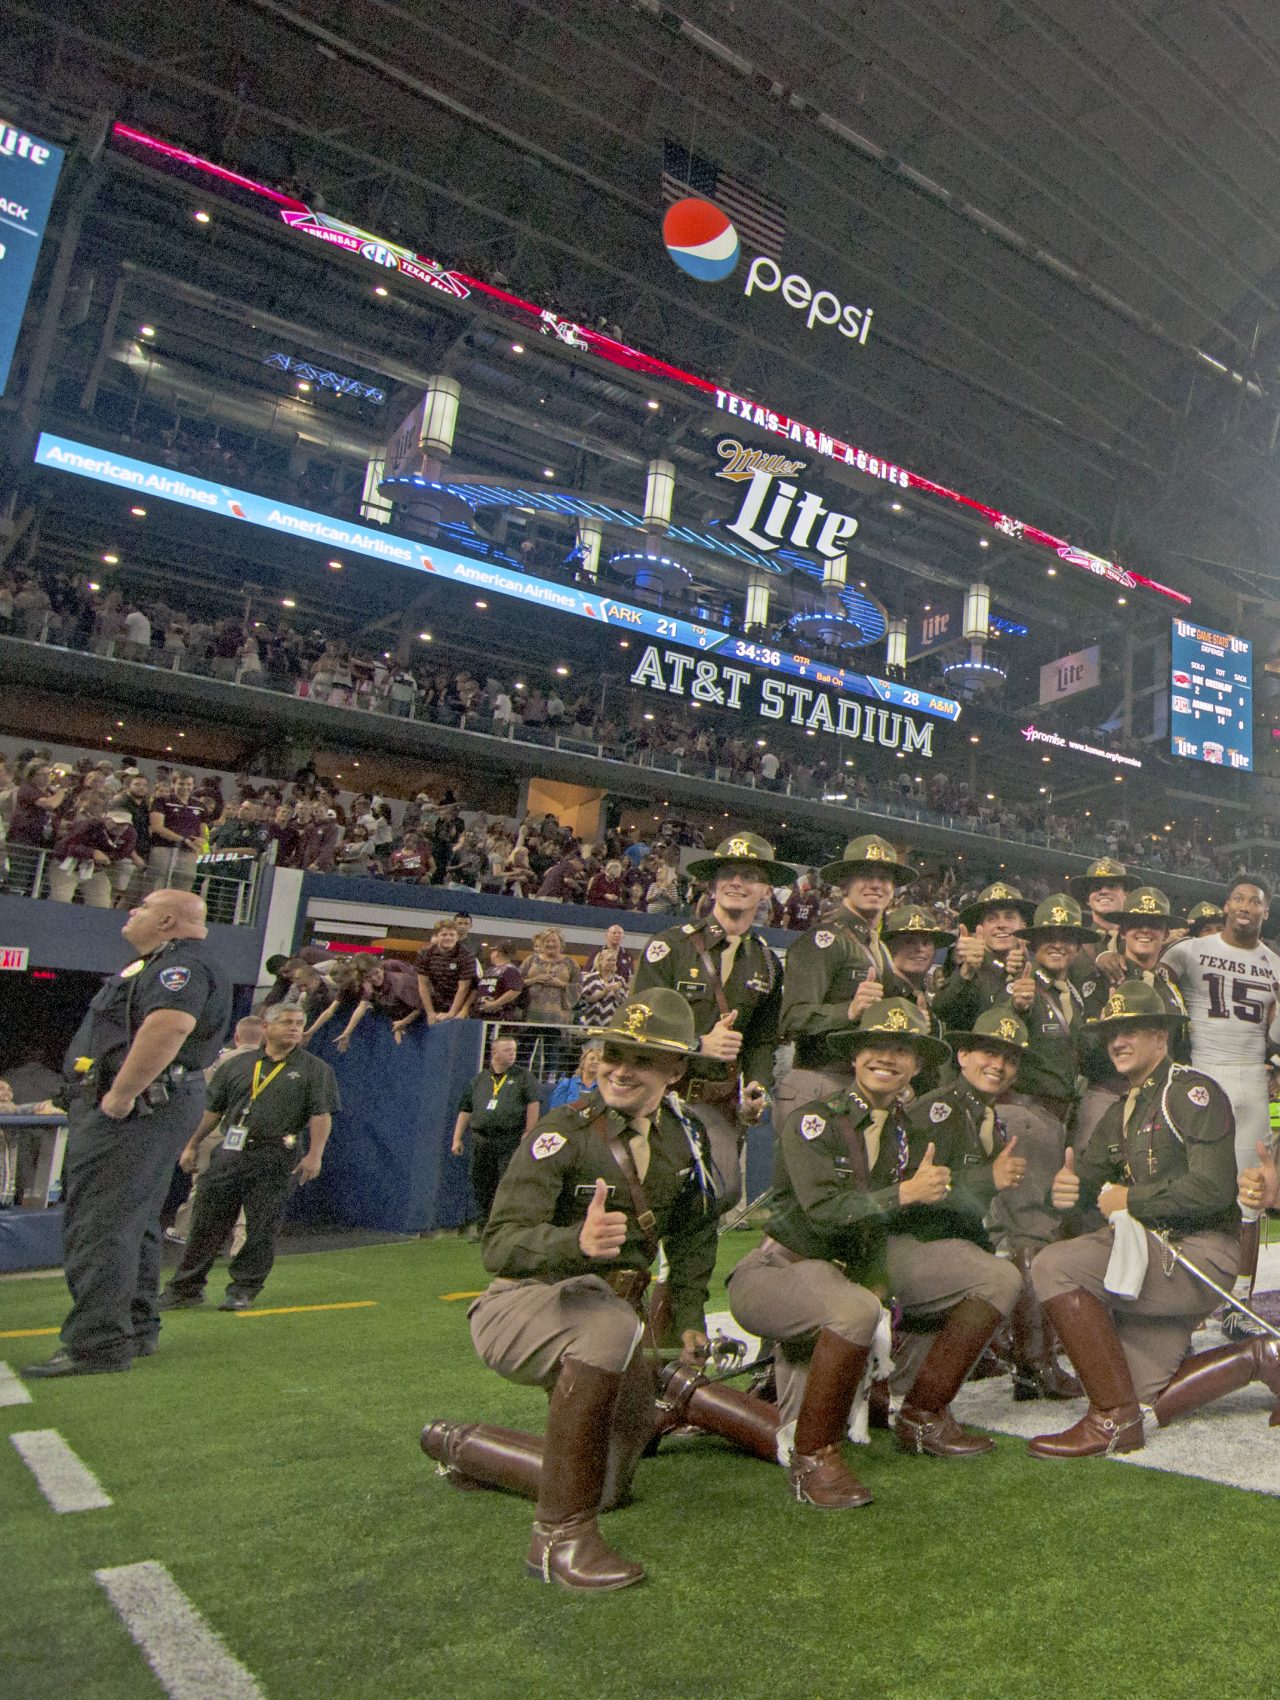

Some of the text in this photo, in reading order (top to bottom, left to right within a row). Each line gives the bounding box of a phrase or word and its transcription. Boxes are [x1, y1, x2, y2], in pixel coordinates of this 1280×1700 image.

[402, 261, 430, 284] TEXAS
[744, 256, 873, 345] pepsi
[716, 390, 910, 489] TEXAS A&M AGGIES
[717, 439, 807, 474] Miller
[46, 446, 218, 506] American Airlines
[726, 466, 858, 558] Lite
[267, 510, 412, 561] American Airlines
[454, 563, 576, 608] American Airlines
[608, 605, 644, 624] ARK
[656, 618, 677, 637] 21
[1177, 621, 1196, 637] Lite
[735, 641, 781, 667] 34:36
[1231, 637, 1249, 653] Lite
[816, 672, 832, 684] Ball
[832, 677, 844, 688] On
[1056, 663, 1084, 692] Lite
[630, 646, 934, 757] AT&T STADIUM
[903, 690, 920, 706] 28
[928, 698, 954, 714] A&M
[1178, 740, 1197, 756] Lite
[1231, 752, 1249, 767] Lite
[0, 949, 24, 968] XIT
[1199, 954, 1246, 975] TEXAS
[1202, 972, 1271, 1024] 15
